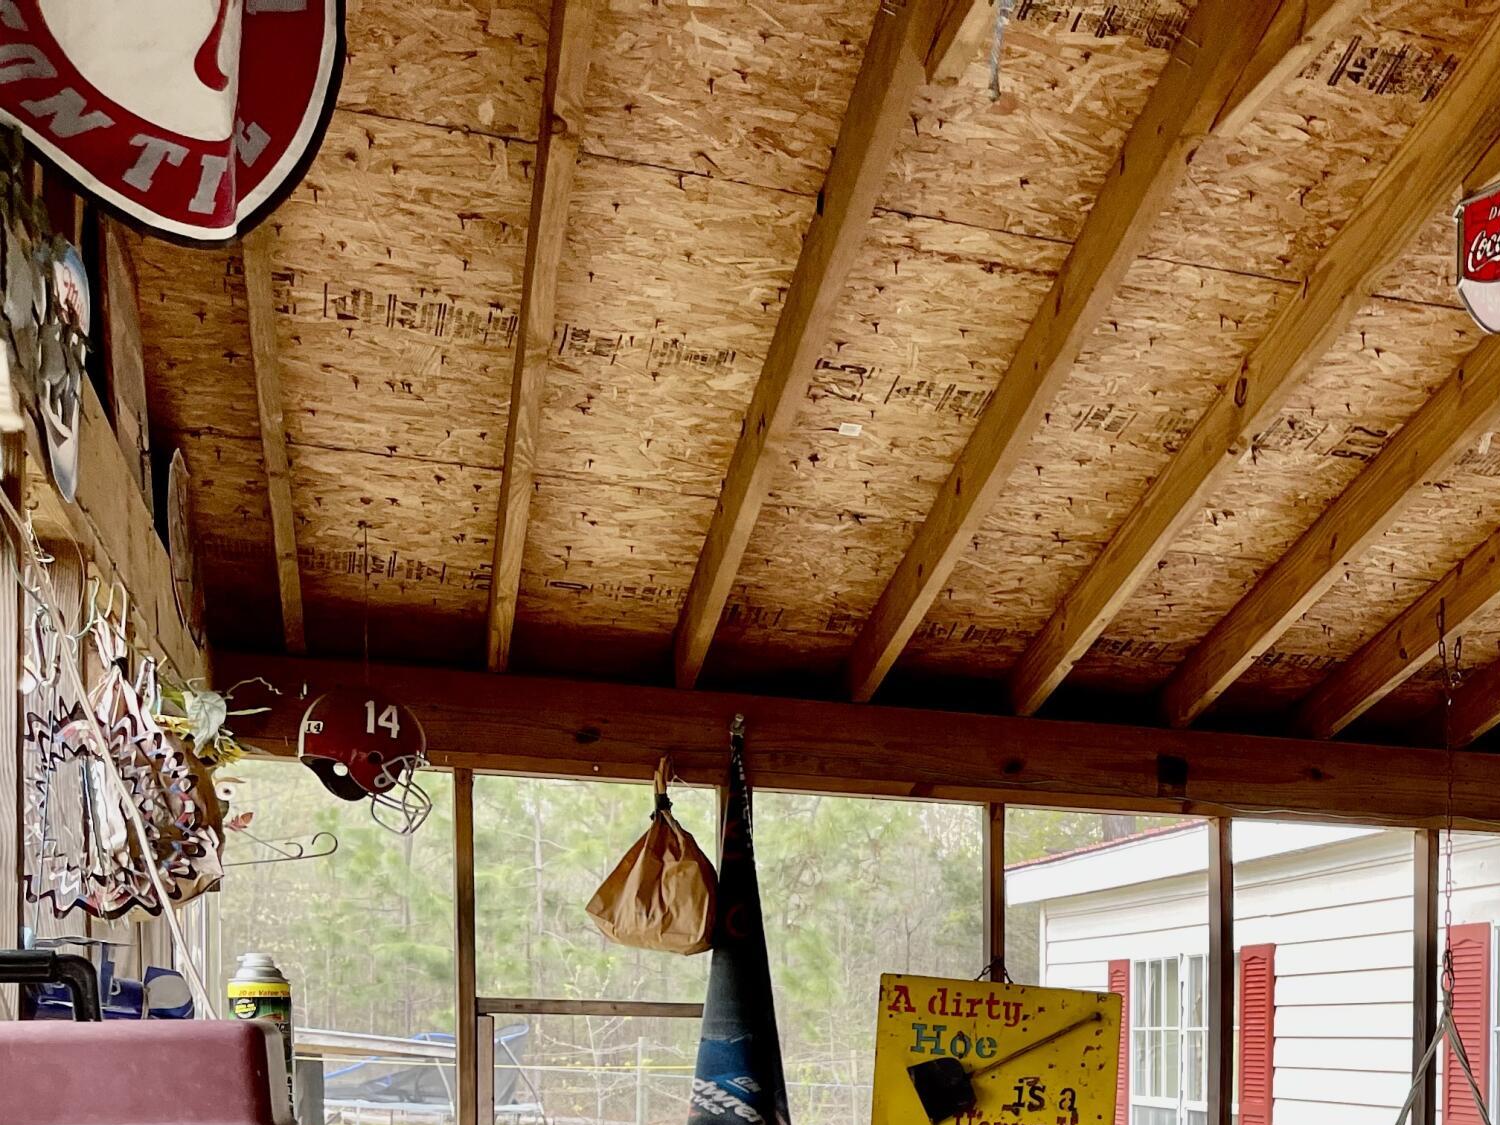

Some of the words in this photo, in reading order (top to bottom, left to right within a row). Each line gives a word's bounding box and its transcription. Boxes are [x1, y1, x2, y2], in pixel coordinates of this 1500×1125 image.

[306, 722, 321, 733] 14
[365, 700, 400, 738] 14
[888, 985, 916, 1013] A
[927, 988, 1023, 1027] dirty
[910, 1022, 998, 1059] Hoe
[1012, 1078, 1046, 1111] is
[1058, 1088, 1078, 1112] a
